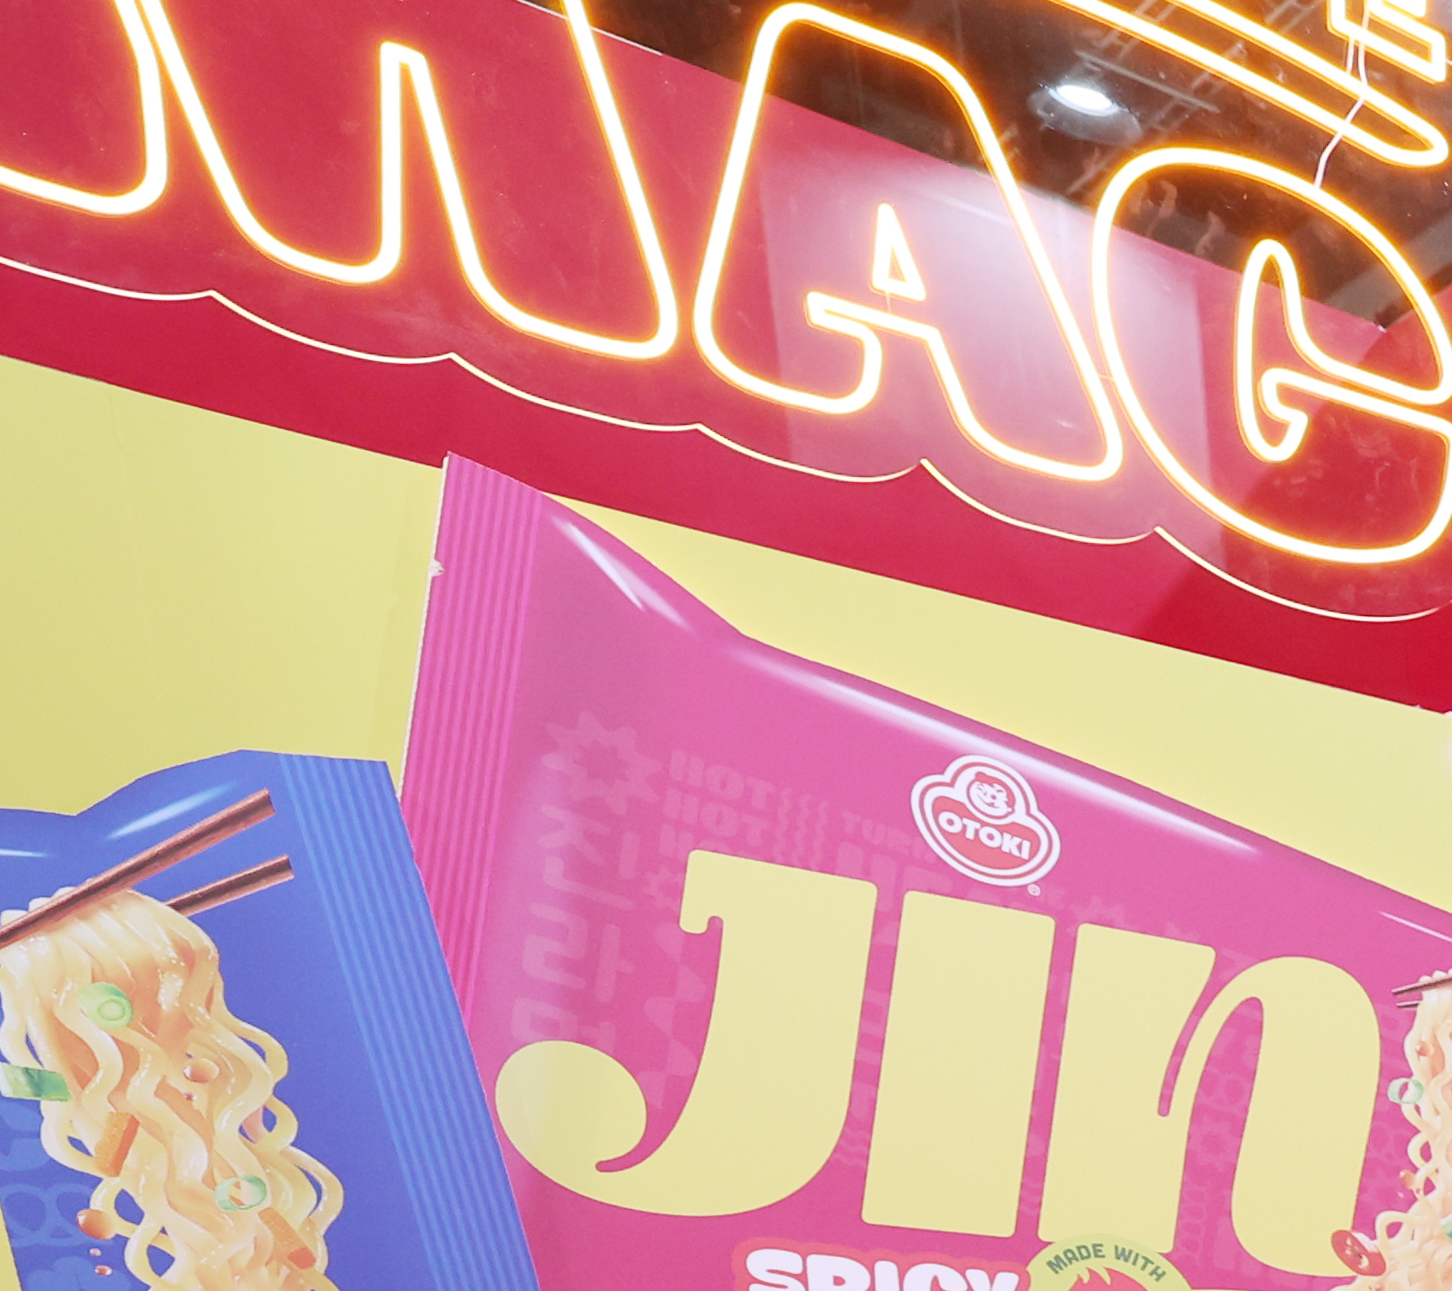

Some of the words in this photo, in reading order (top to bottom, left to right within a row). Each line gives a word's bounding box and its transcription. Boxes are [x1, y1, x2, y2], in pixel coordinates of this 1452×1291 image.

[938, 811, 1031, 860] OTOKI
[1046, 1244, 1105, 1274] MADE
[1114, 1245, 1166, 1282] WITH
